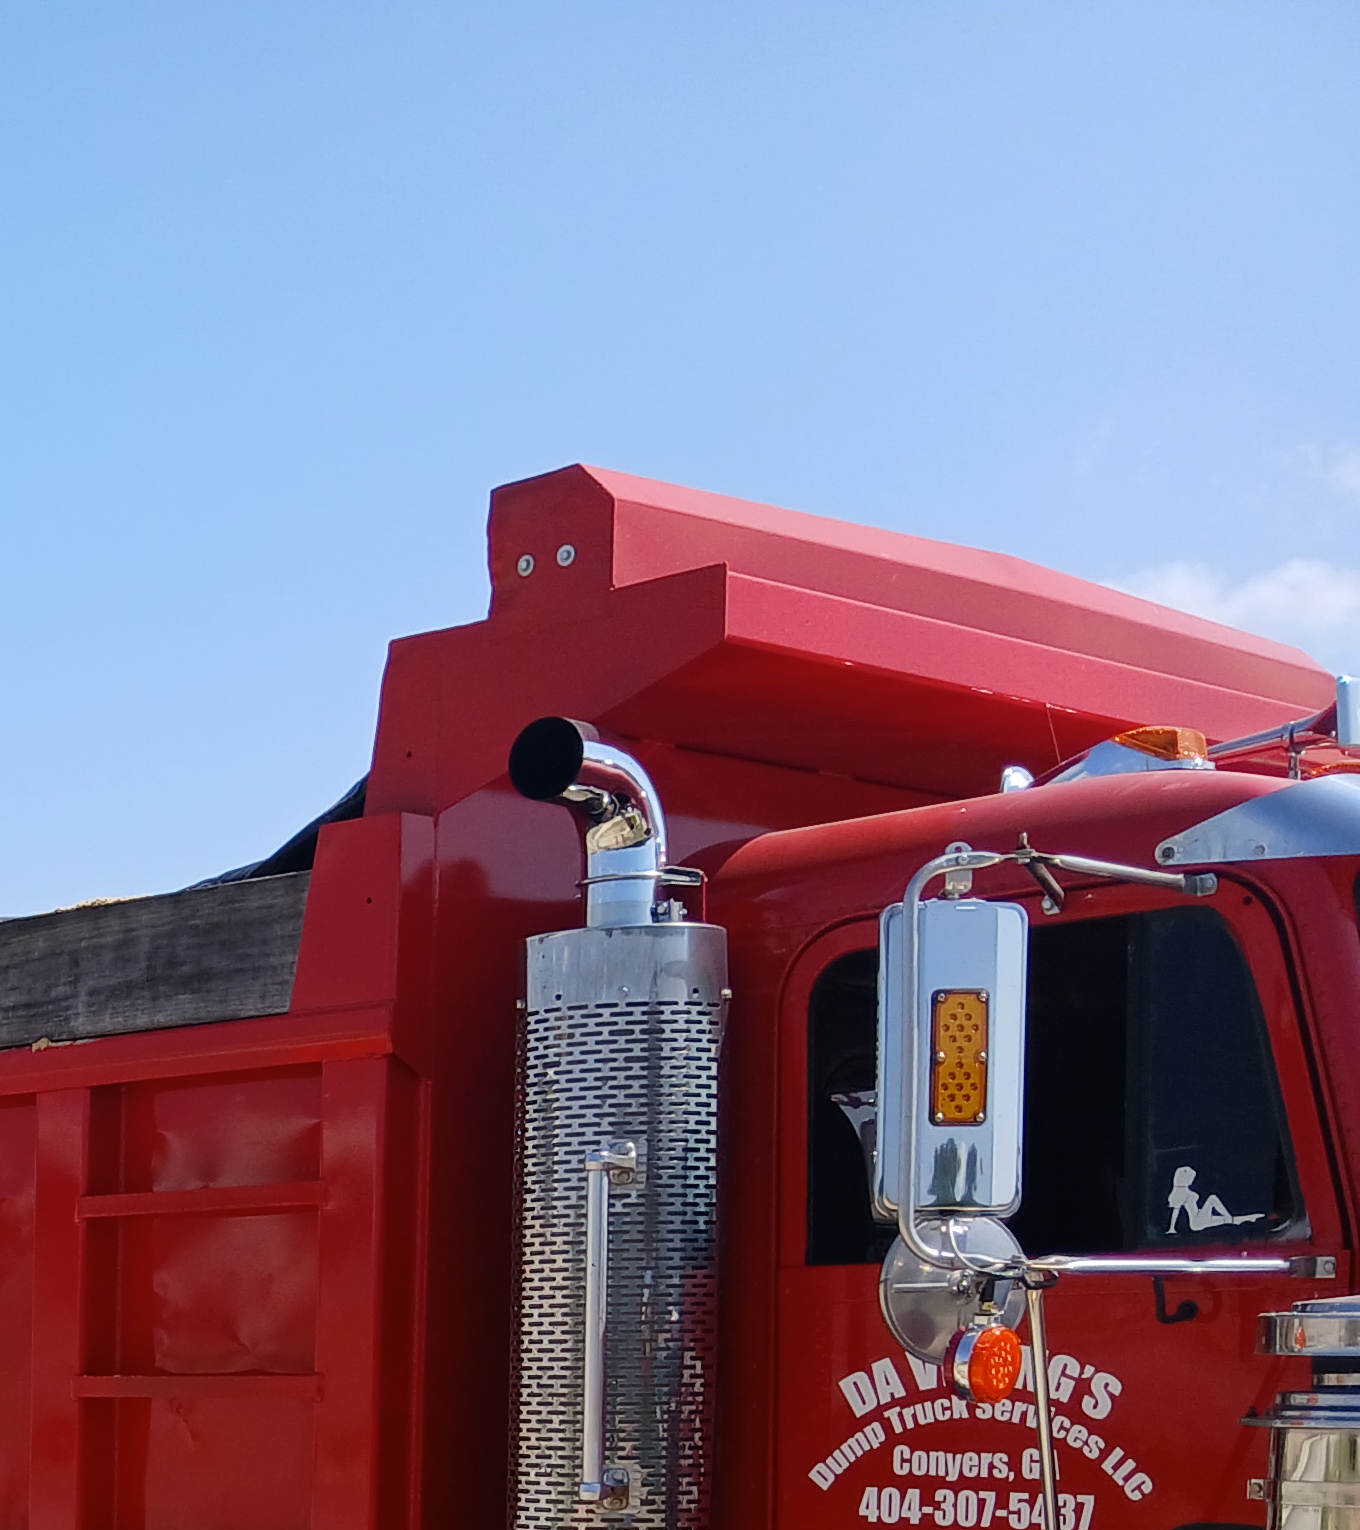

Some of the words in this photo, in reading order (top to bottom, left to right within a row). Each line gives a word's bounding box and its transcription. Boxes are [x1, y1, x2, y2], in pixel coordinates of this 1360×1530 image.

[808, 1421, 886, 1491] Dump
[883, 1394, 970, 1434] Truck
[975, 1397, 1106, 1460] Servces
[1100, 1446, 1154, 1502] LLC
[892, 1444, 1015, 1482] Conyers,
